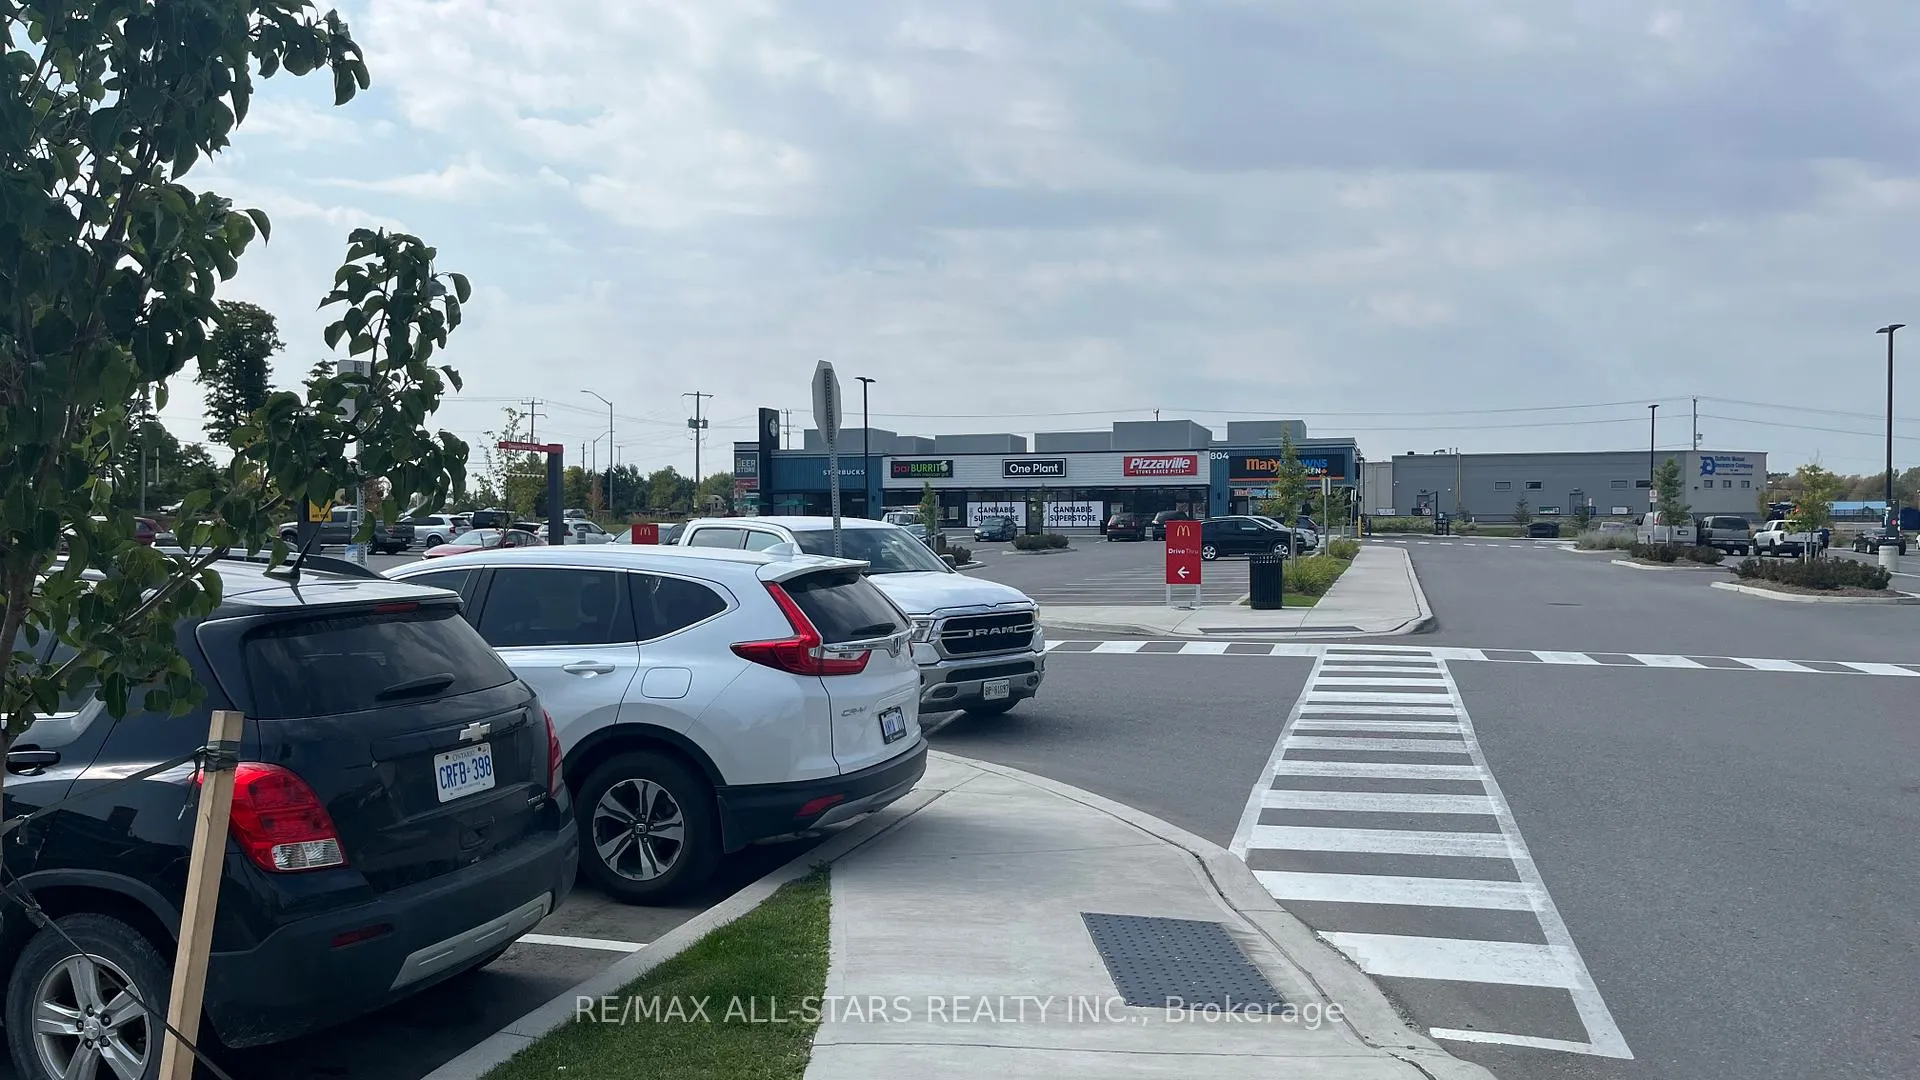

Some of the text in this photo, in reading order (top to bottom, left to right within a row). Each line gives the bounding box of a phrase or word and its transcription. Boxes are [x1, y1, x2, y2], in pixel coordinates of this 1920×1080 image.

[1210, 452, 1229, 460] 804
[1009, 463, 1058, 473] One Plant
[1129, 457, 1190, 469] Pizzaville
[1050, 514, 1097, 522] SUPERSTORE
[975, 625, 1014, 636] RAM
[440, 755, 492, 790] CRFB 398
